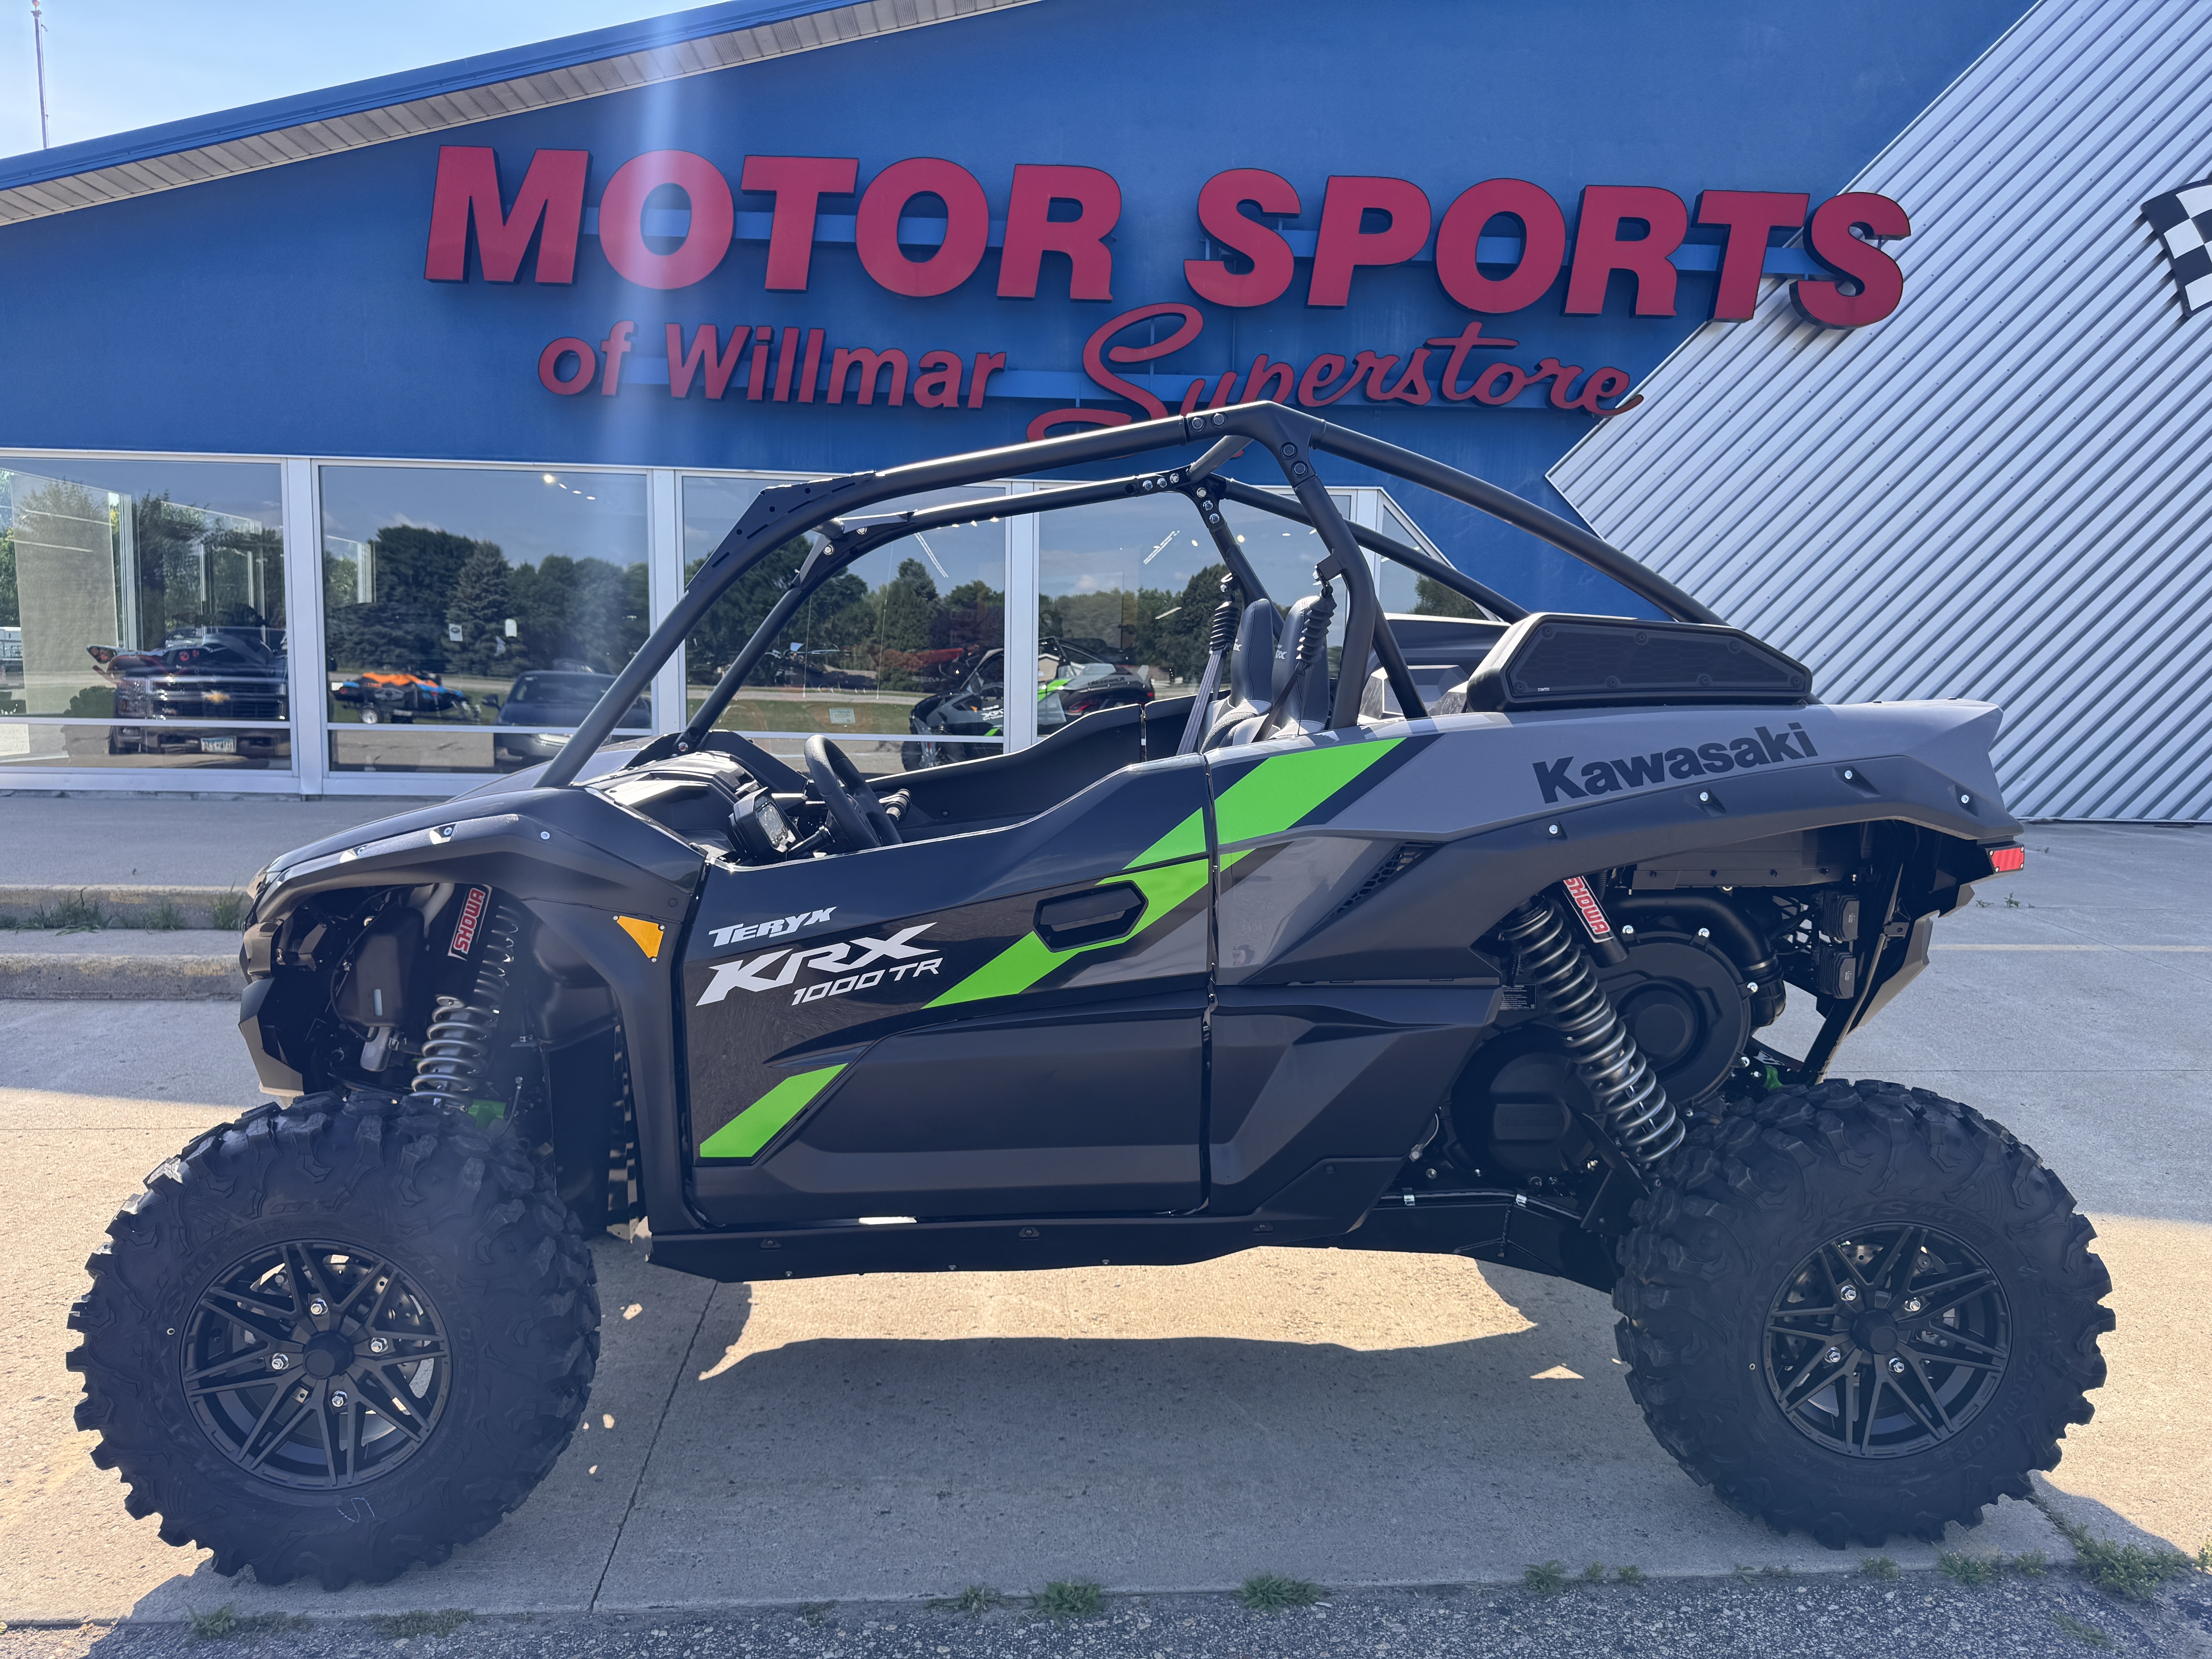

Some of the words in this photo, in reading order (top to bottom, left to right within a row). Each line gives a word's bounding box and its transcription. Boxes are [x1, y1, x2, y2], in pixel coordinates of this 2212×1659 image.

[424, 145, 1122, 301] MOTOR
[1184, 167, 1911, 329] SPORTS
[537, 321, 635, 397] of
[665, 323, 1007, 409] Willmar
[1026, 303, 1644, 459] Superstore
[1532, 722, 1819, 804] Kawasaki
[453, 888, 486, 954] SHOWA
[708, 906, 837, 947] TERYX
[1563, 876, 1610, 934] SHOWA
[696, 922, 941, 1006] KRX
